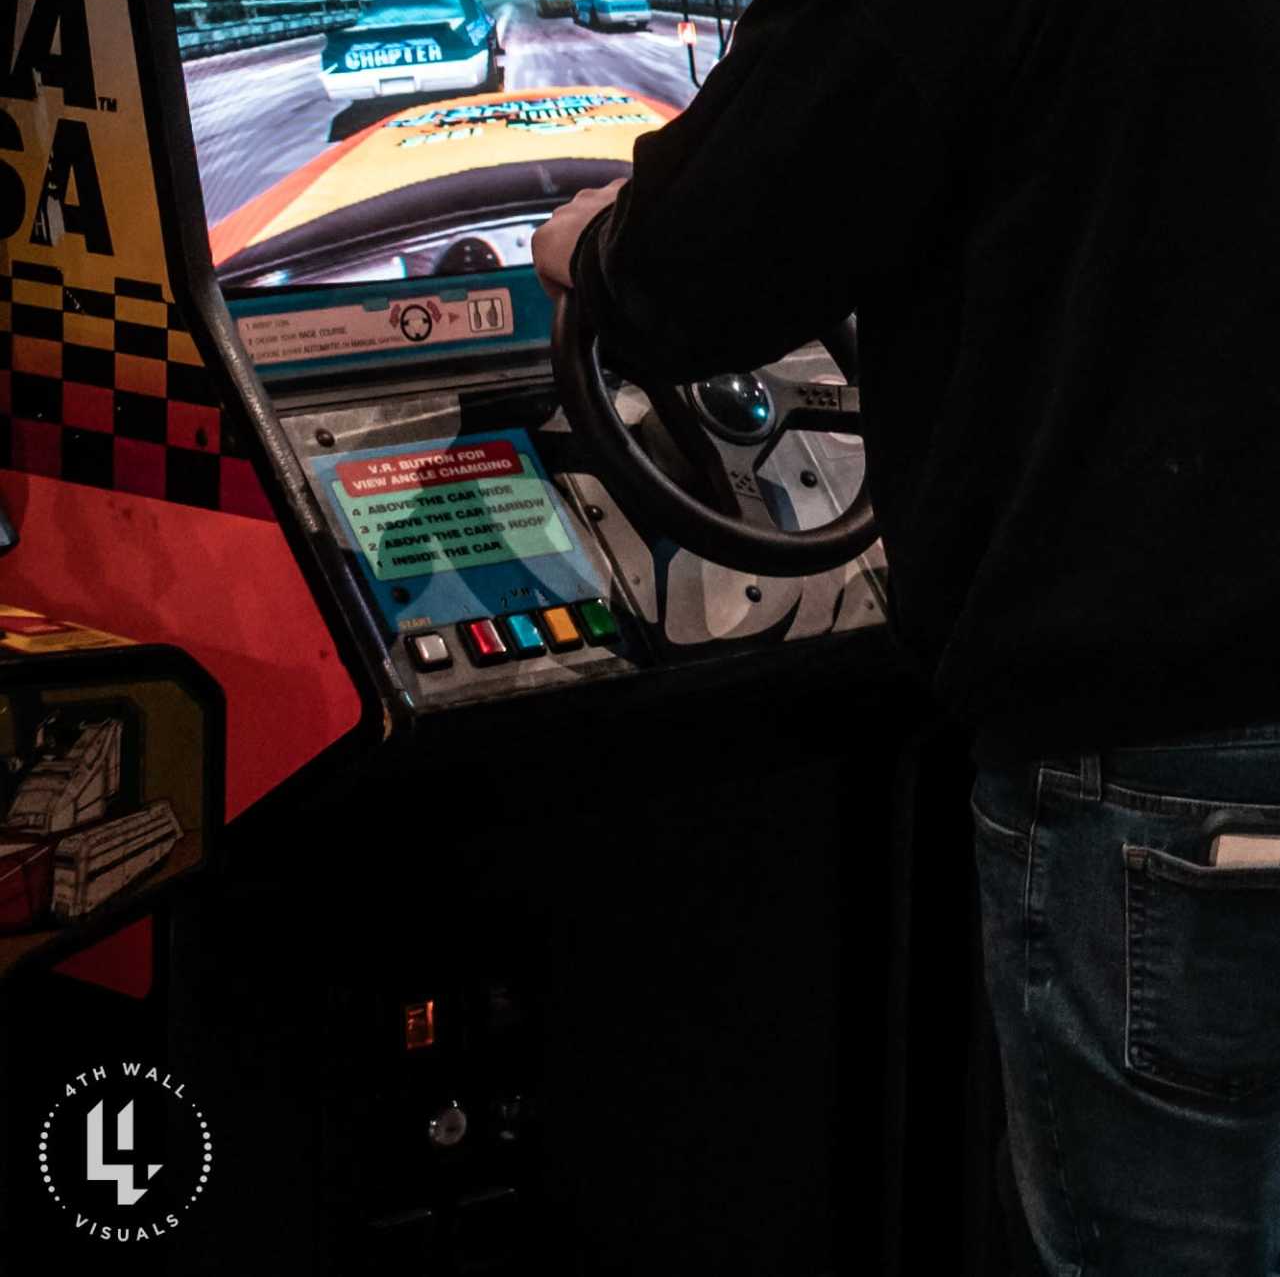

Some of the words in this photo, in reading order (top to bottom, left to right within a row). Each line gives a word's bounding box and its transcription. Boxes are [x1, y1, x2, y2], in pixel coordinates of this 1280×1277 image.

[352, 476, 387, 490] VIEW
[390, 468, 436, 485] ANGLE
[438, 459, 513, 479] CHANGING
[367, 460, 402, 475] V.R.
[400, 451, 454, 470] BUTTON
[457, 448, 486, 462] FOR
[367, 498, 417, 516] ABOVE
[416, 492, 446, 508] THE
[446, 488, 476, 504] CAR
[478, 483, 514, 499] WIDE
[376, 516, 424, 533] ABOVE
[426, 510, 454, 526] THE
[455, 505, 484, 521] CAR
[486, 496, 545, 515] NARROW
[384, 533, 434, 550] ABOVE
[433, 527, 462, 543] THE
[391, 550, 440, 567] INSIDE
[443, 544, 471, 560] THE
[473, 539, 502, 555] CAR
